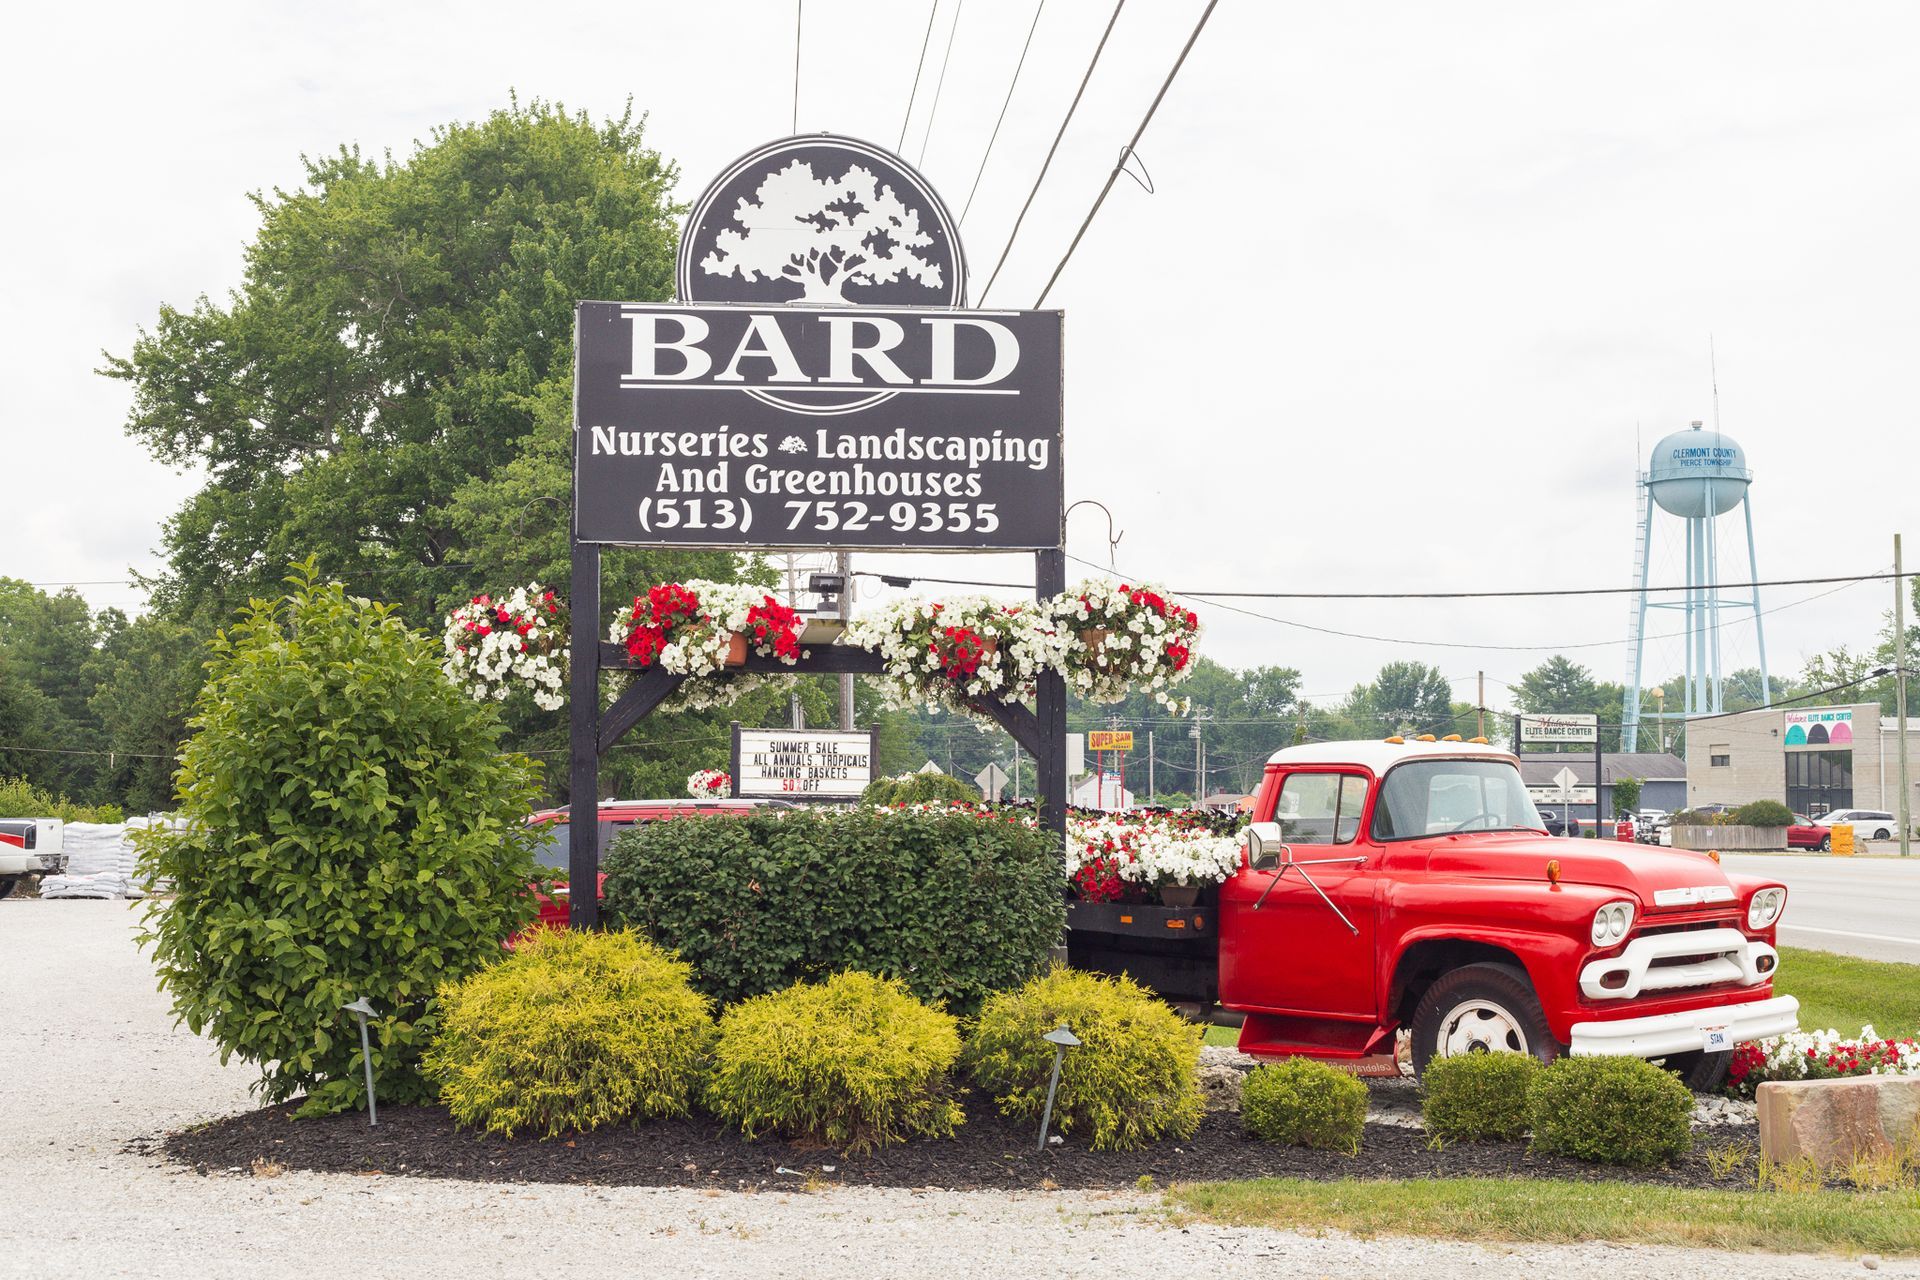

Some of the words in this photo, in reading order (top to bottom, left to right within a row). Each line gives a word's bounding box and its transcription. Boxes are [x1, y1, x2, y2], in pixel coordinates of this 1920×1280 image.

[620, 313, 1020, 385] BARD
[591, 426, 768, 458] Nurseries
[815, 428, 1049, 471] Landscaping
[1673, 448, 1710, 459] CLERMONT
[1713, 448, 1736, 458] COUNTY
[1680, 459, 1702, 467] PIERCE
[656, 462, 728, 493] And
[745, 464, 982, 498] Greenhouses
[639, 497, 753, 533] (513)
[784, 500, 1000, 534] 752-9355
[1807, 713, 1820, 722] ELITE
[1525, 727, 1543, 735] ELITE
[1544, 727, 1566, 735] DANCE
[1567, 727, 1592, 736] CENTER
[1091, 733, 1113, 748] SUPER
[1115, 733, 1131, 742] SAM
[770, 741, 809, 753] SUMMER
[816, 742, 838, 754] SALE
[754, 754, 768, 766] ALL
[822, 755, 867, 767] TROPICALS
[761, 767, 801, 778] HANGING
[808, 767, 848, 779] BASKETS
[803, 779, 820, 791] OFF
[1710, 1033, 1724, 1044] STAN
